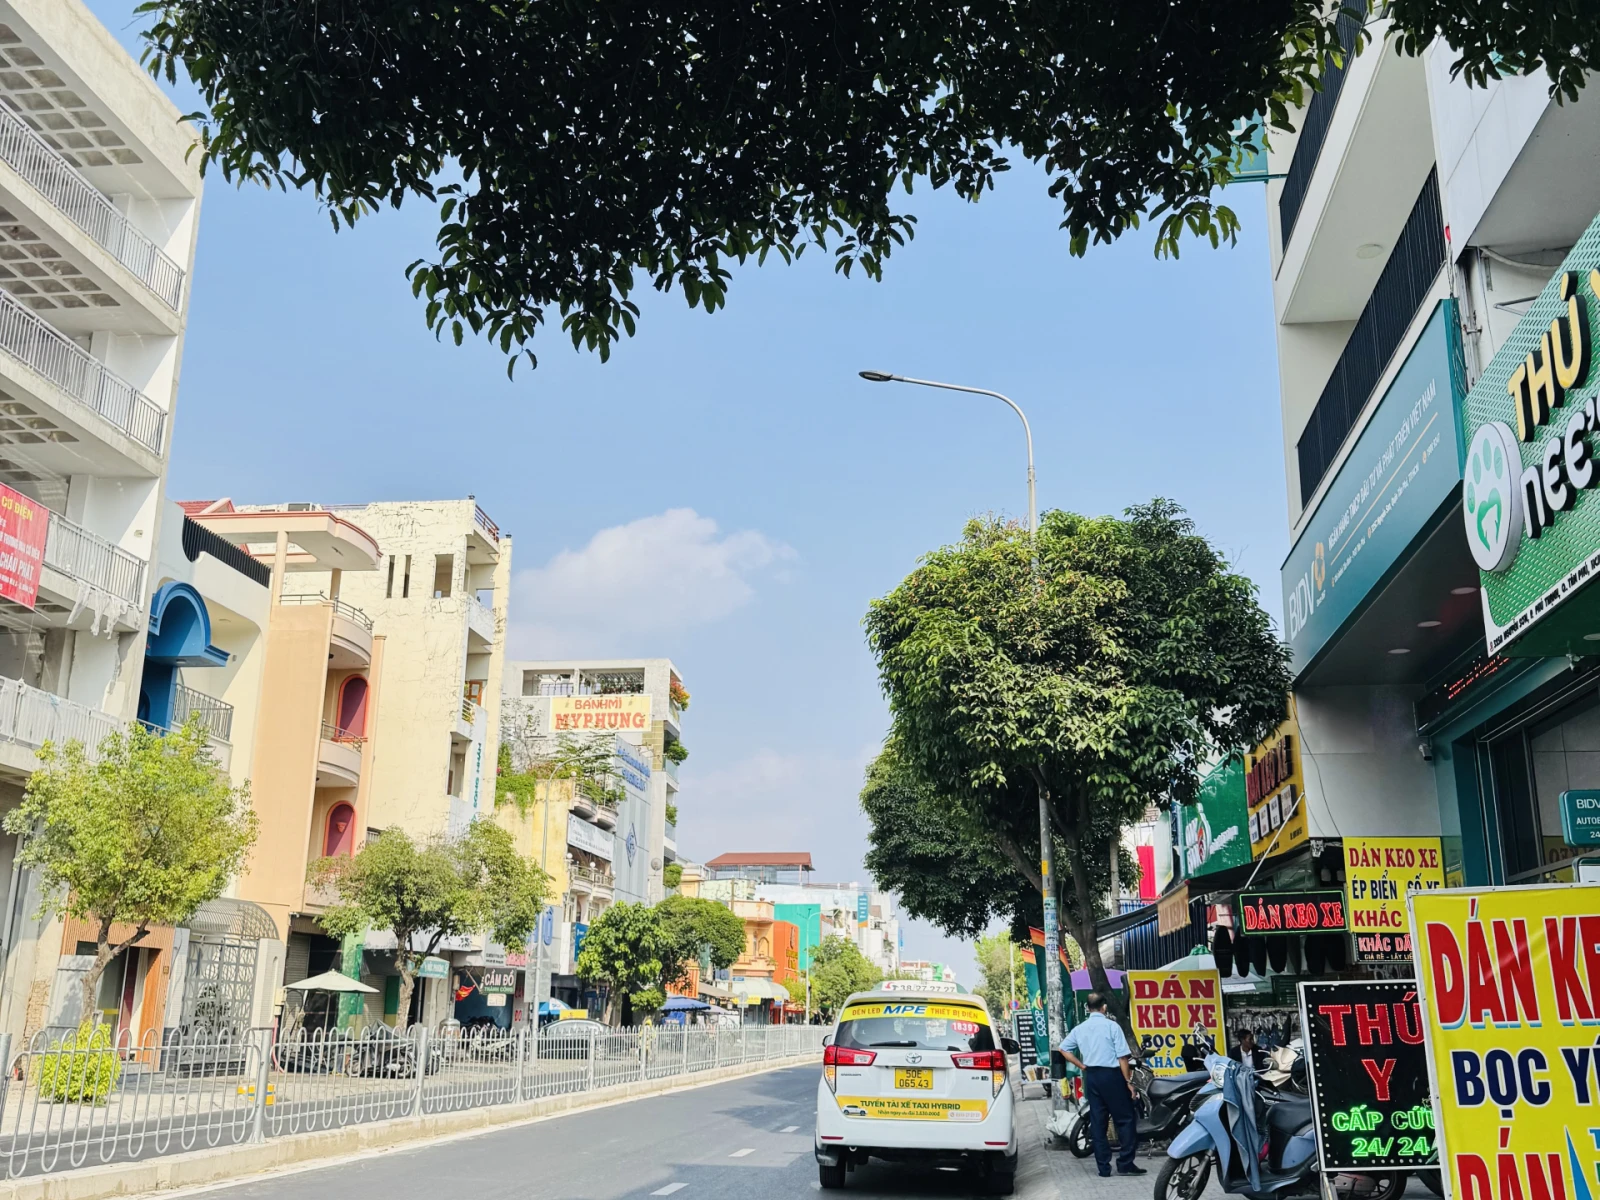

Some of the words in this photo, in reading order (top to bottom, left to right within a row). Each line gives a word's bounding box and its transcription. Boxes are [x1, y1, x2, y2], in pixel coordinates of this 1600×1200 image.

[1508, 272, 1582, 441] THÚ
[1421, 378, 1437, 411] NAM
[1289, 560, 1315, 641] BIDV
[1348, 842, 1381, 868] DÁN
[1384, 848, 1416, 868] KEO
[1418, 848, 1439, 868] XE
[1351, 874, 1367, 899] ÉP
[1370, 870, 1398, 900] BIỂN
[1283, 902, 1318, 928] KEO
[1320, 902, 1344, 926] XE
[1353, 902, 1403, 927] KHẮC
[1358, 933, 1391, 952] KHẮC
[1395, 932, 1412, 952] DẤ
[1425, 897, 1542, 1028] DÁN
[1544, 915, 1600, 1026] KE
[1133, 974, 1215, 999] DÁN
[883, 1005, 928, 1015] MPE
[1136, 1004, 1181, 1029] KEO
[1187, 1004, 1218, 1029] XE
[1318, 992, 1425, 1046] THÚ
[899, 1079, 929, 1088] 065.43
[905, 1070, 922, 1079] 50E
[1361, 1058, 1397, 1101] Y
[1451, 1049, 1551, 1119] BỌC
[1331, 1104, 1384, 1131] CẤP
